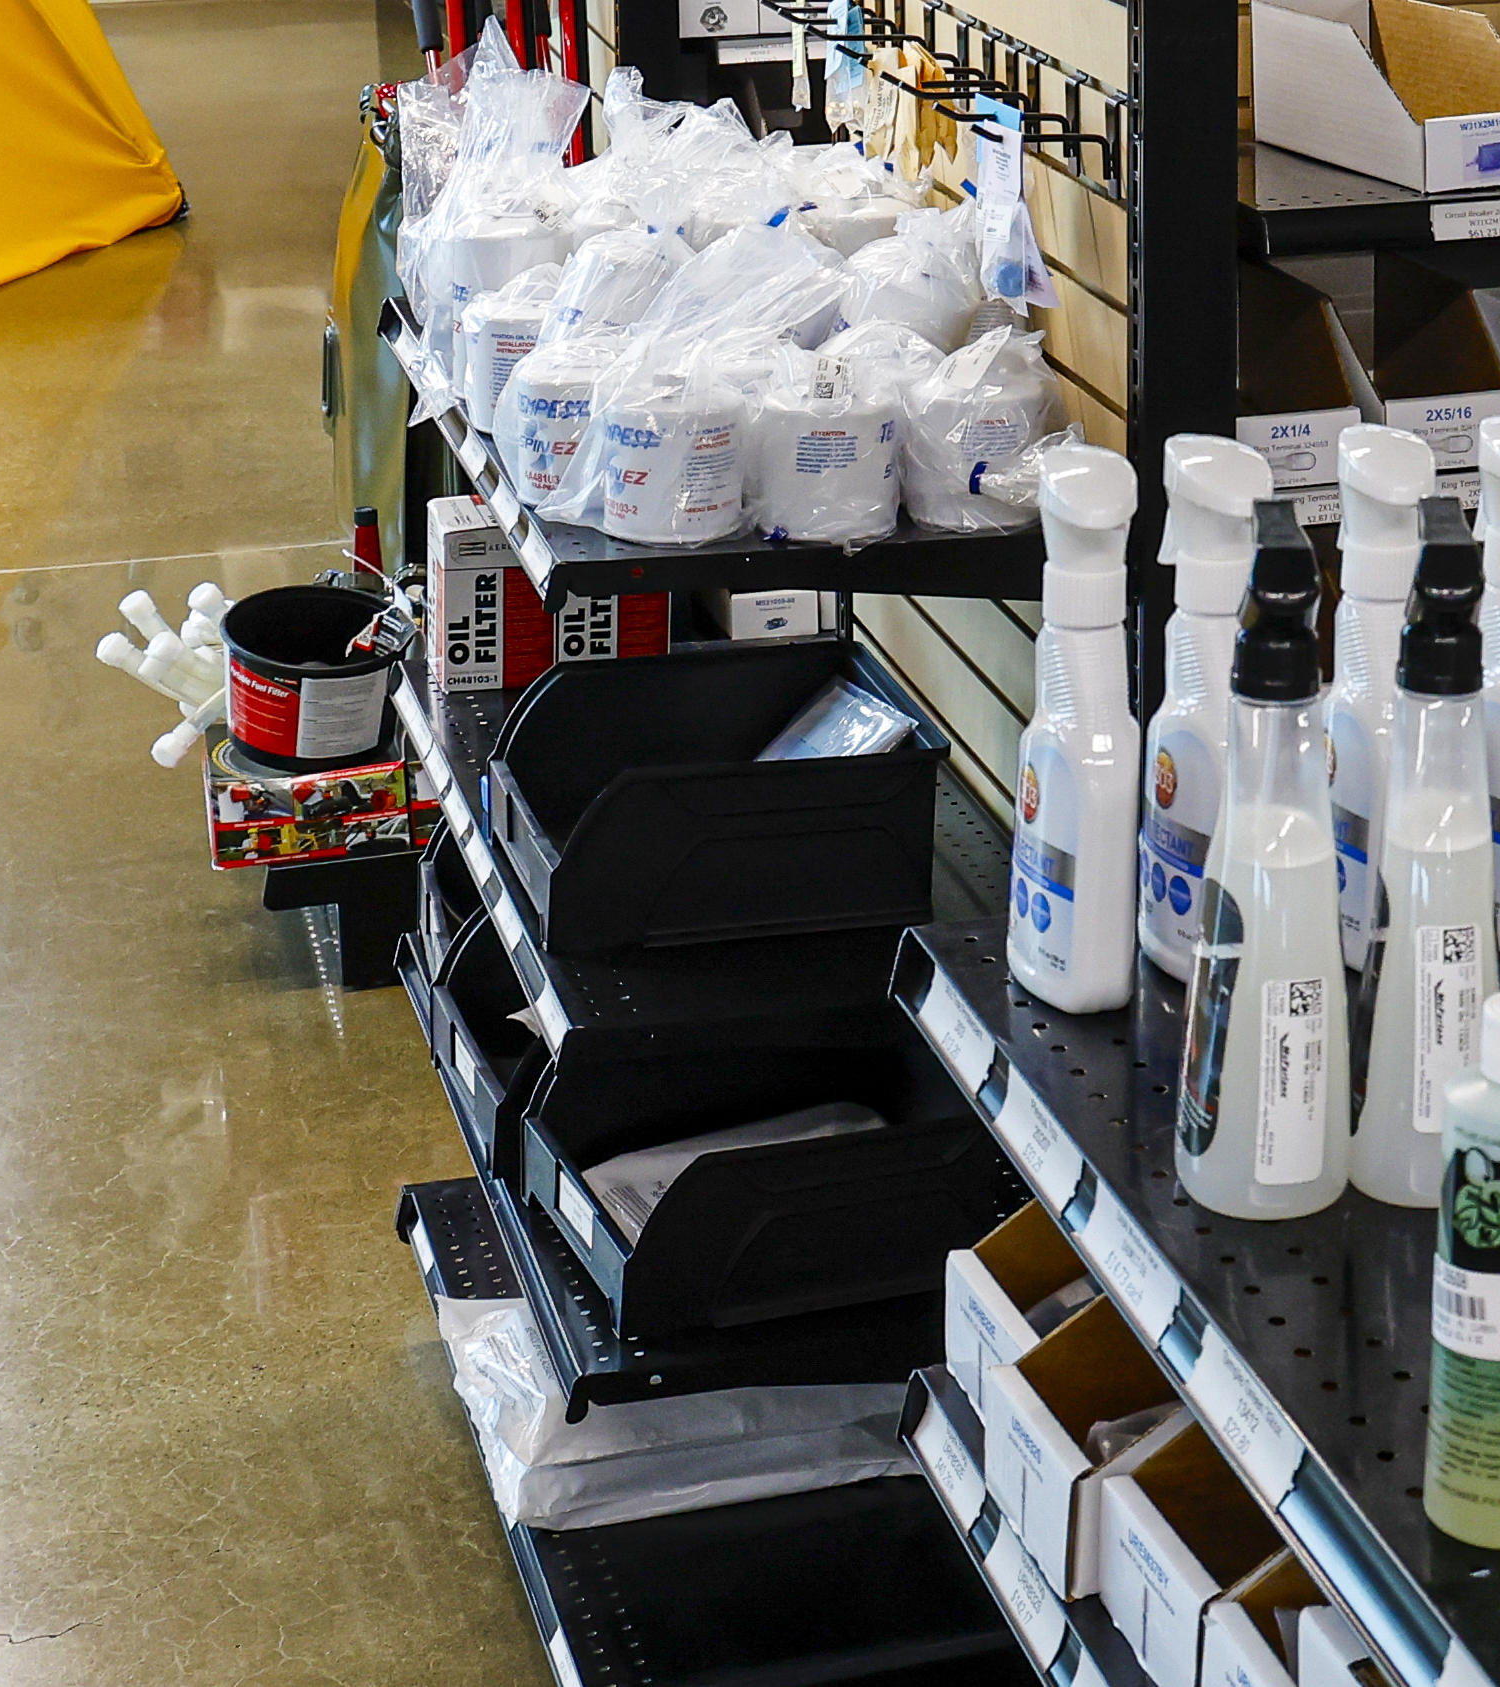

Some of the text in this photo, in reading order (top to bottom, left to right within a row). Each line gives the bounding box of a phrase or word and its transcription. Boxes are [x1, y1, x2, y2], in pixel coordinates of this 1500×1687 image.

[1469, 210, 1494, 218] Breaker
[1425, 406, 1472, 422] 2X5/16
[1271, 423, 1311, 439] 2X1/4
[550, 440, 577, 456] EZ
[622, 470, 648, 486] EZ
[1441, 481, 1457, 492] Ring
[1317, 502, 1340, 512] 2X1/4
[475, 572, 498, 663] FILTER
[448, 616, 471, 665] OIL
[563, 608, 585, 657] OIL
[250, 678, 290, 700] Fuel Filter
[447, 675, 499, 687] CH48103-1
